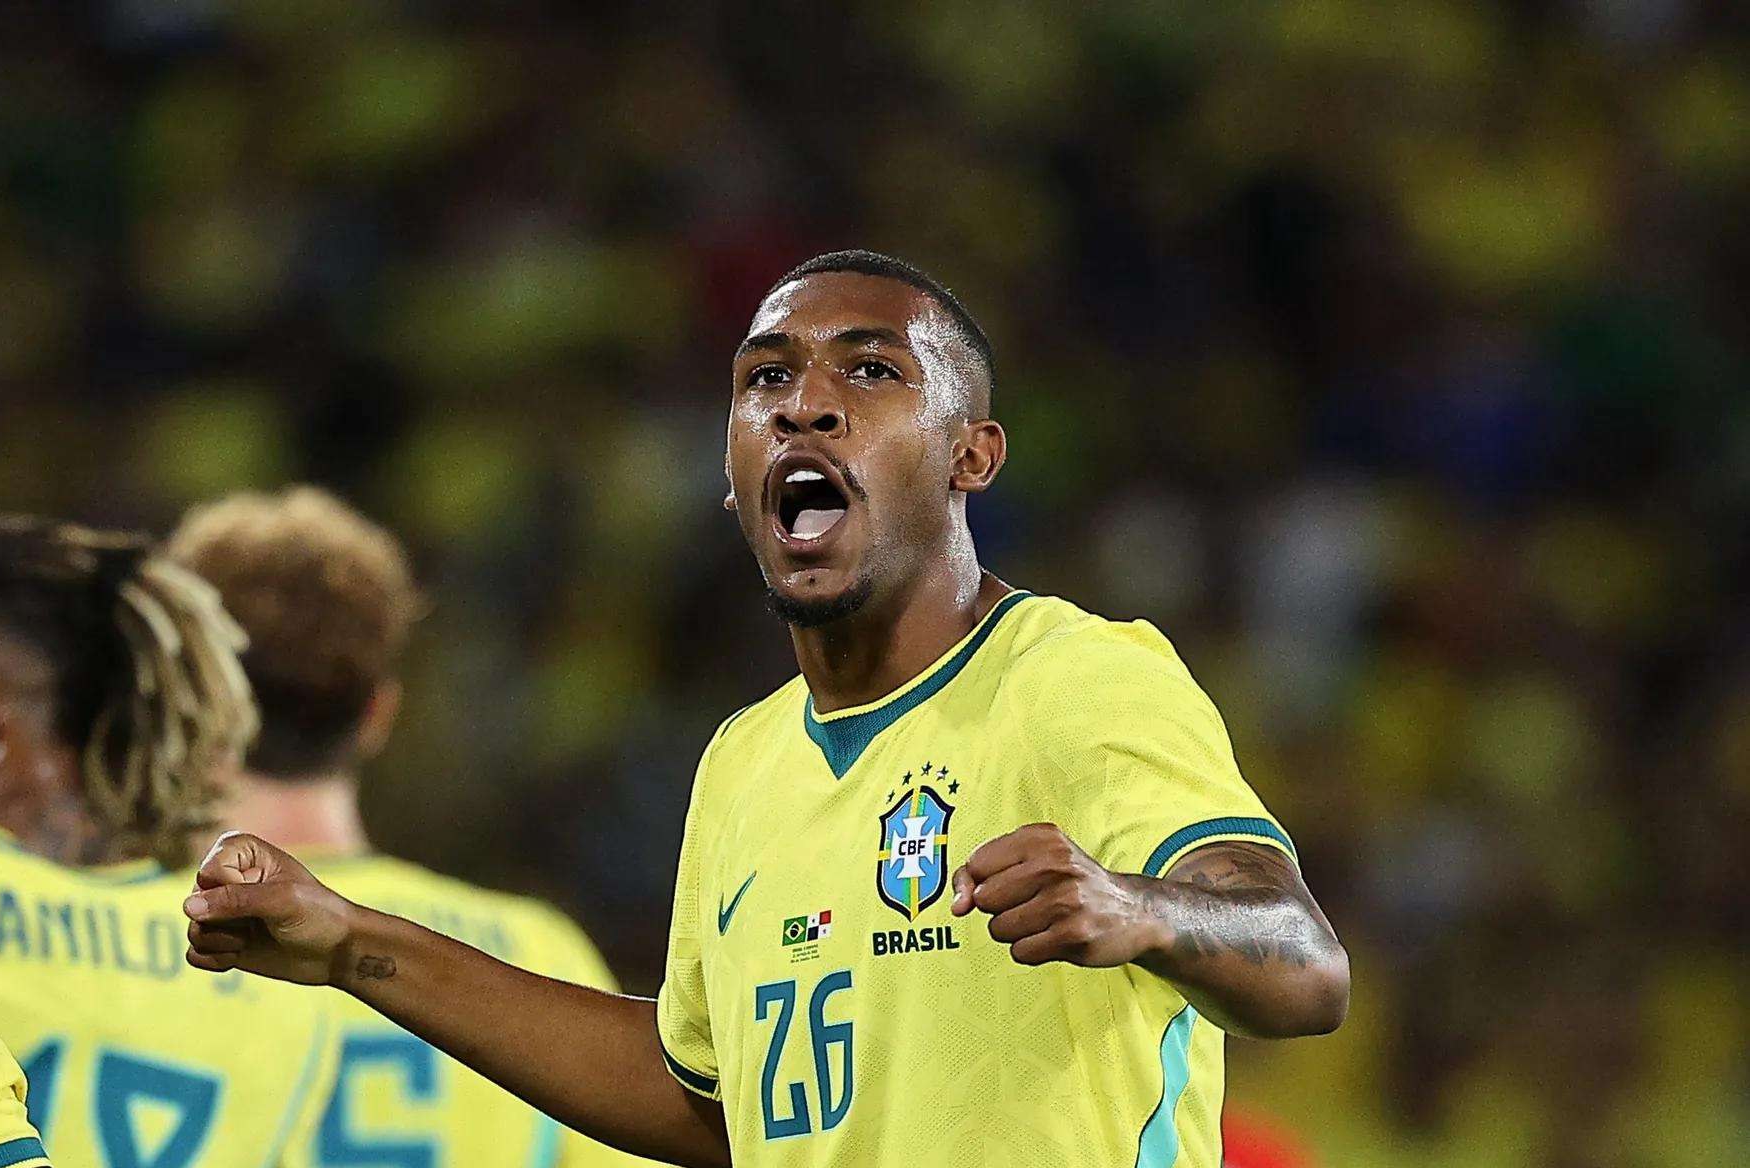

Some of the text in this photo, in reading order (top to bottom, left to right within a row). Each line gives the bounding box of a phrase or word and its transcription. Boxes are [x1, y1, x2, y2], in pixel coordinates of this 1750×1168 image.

[898, 838, 927, 856] CBF
[872, 925, 961, 956] BRASIL
[754, 969, 855, 1141] 26
